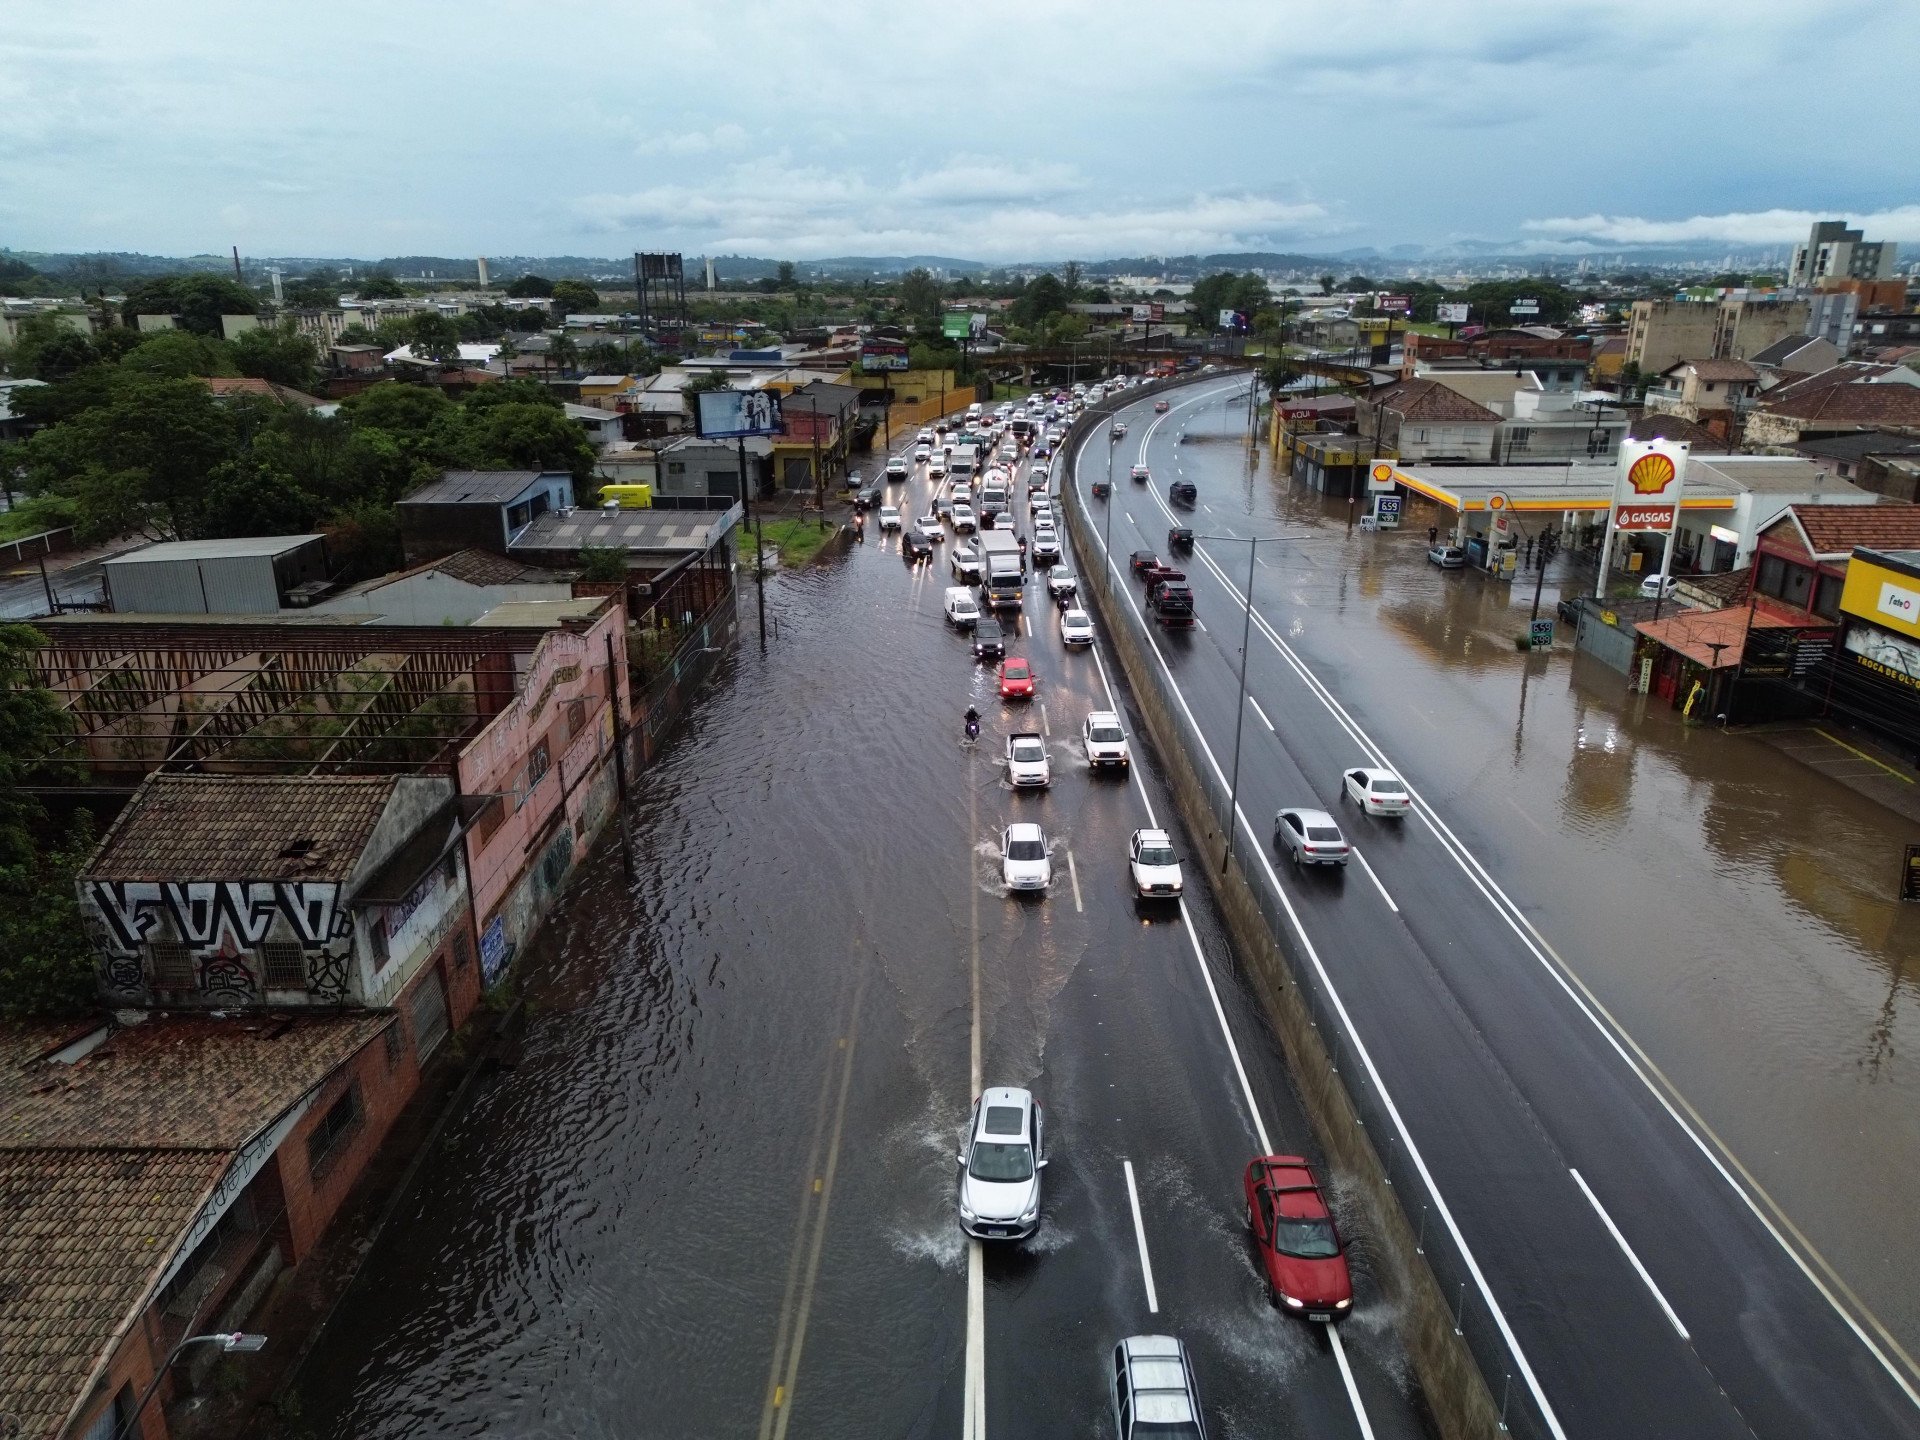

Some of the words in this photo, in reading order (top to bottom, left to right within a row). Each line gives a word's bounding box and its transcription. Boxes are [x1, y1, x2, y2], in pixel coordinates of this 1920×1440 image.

[1291, 410, 1310, 420] AQUI
[1381, 502, 1398, 511] 6.59
[1631, 512, 1671, 523] GASGAS
[1533, 623, 1551, 633] 6.59
[1533, 635, 1550, 645] 4.99
[1857, 655, 1885, 673] TROCA
[1885, 668, 1897, 679] DE
